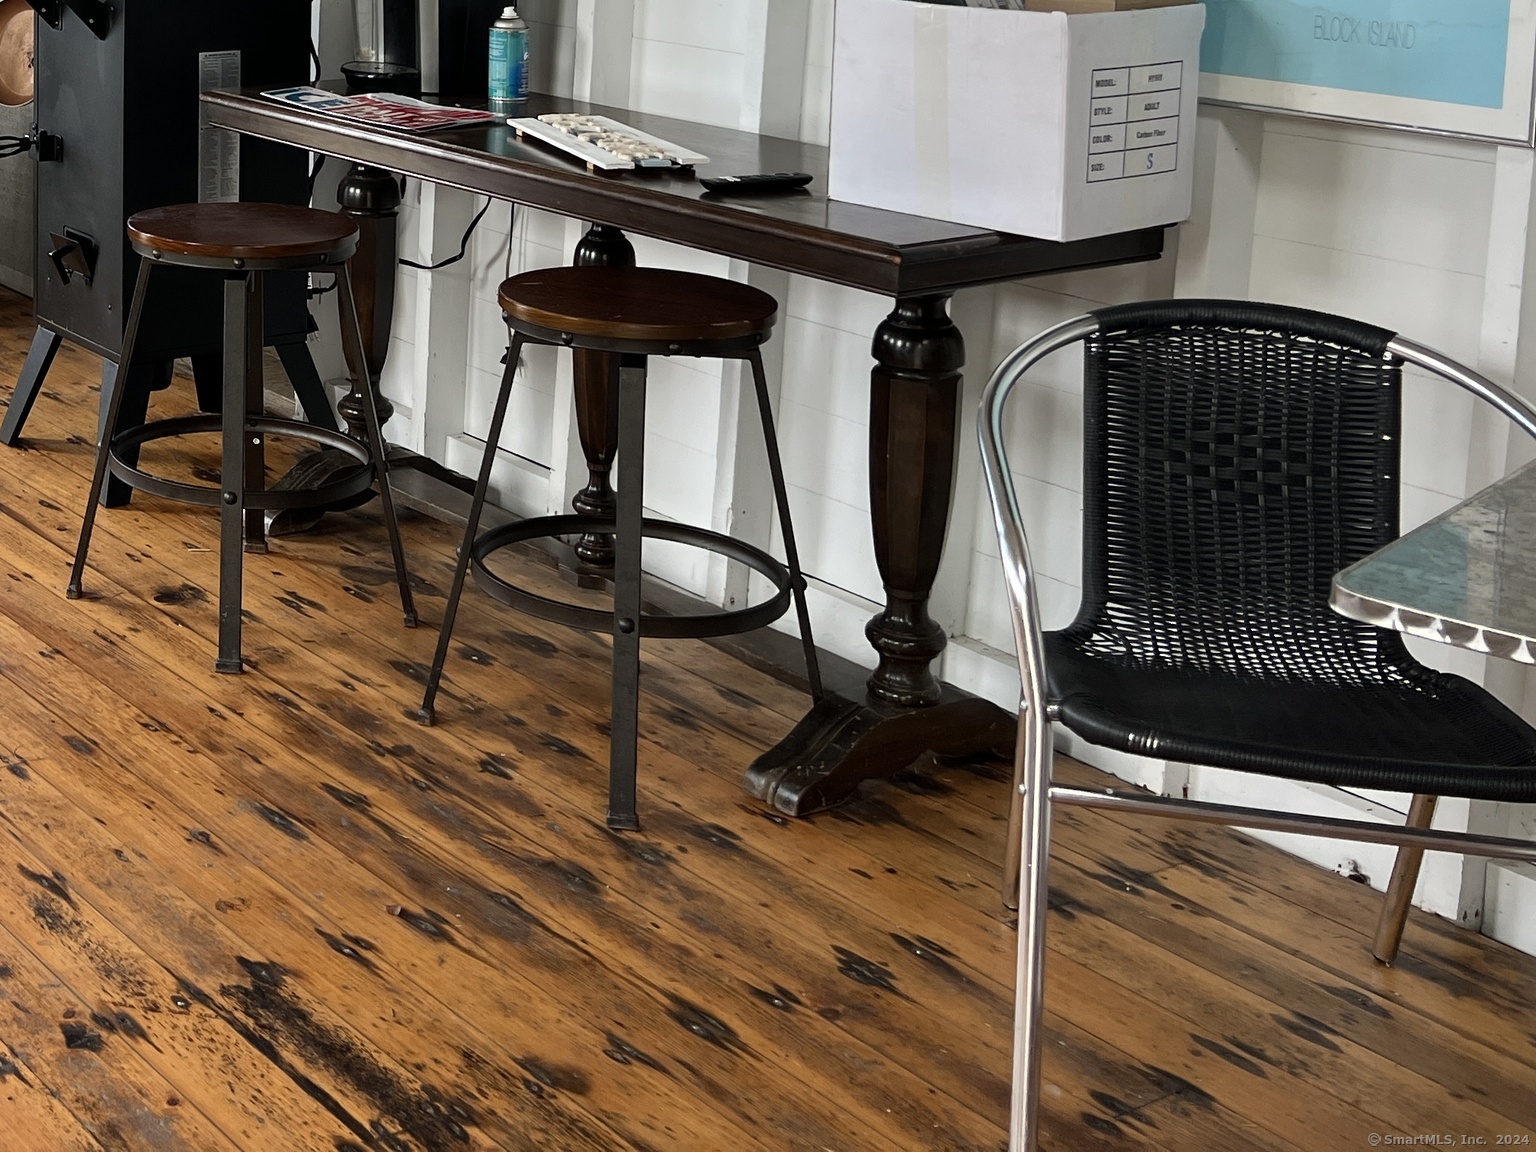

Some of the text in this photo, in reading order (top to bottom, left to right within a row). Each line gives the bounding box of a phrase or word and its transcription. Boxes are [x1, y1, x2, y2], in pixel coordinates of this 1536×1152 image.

[1313, 14, 1416, 50] BLOCK ISLAND
[1095, 79, 1116, 88] MODEL:
[1094, 102, 1160, 116] STYLE: ADULT
[1092, 134, 1113, 144] COLOR:
[1091, 153, 1154, 172] SIZE: S
